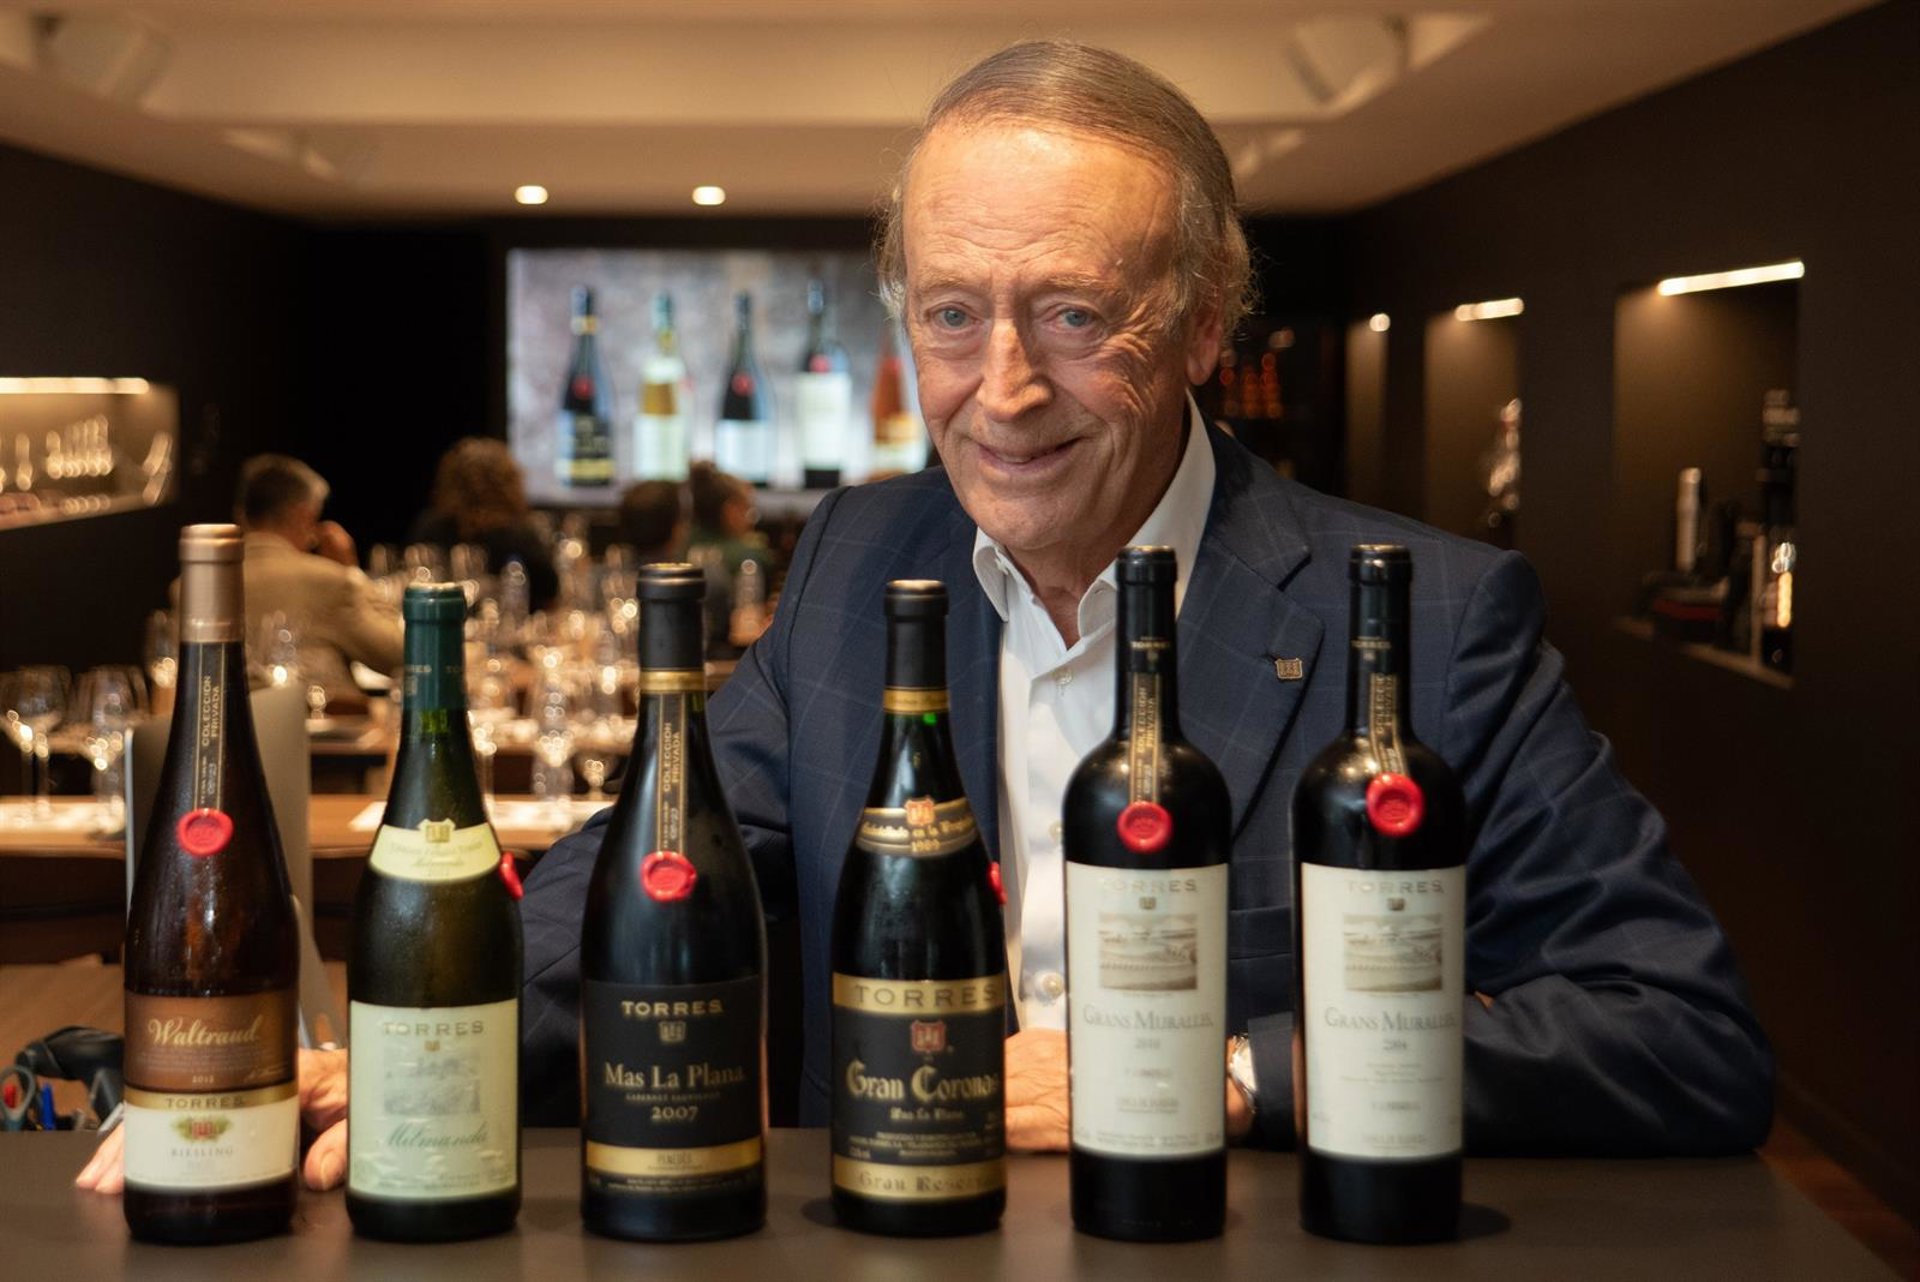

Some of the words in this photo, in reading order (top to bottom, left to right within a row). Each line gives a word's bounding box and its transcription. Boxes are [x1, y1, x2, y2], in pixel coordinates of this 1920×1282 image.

[202, 675, 213, 748] COLECCION
[211, 686, 220, 739] PRIVADA
[663, 721, 673, 793] COLECCION
[672, 731, 681, 784] PRIVADA
[1347, 880, 1445, 894] TORRES
[622, 999, 724, 1017] TORRES
[855, 984, 998, 1008] TORRES
[148, 1014, 261, 1047] Waltraud
[383, 1020, 485, 1037] TORRES
[604, 1062, 645, 1087] Mas
[652, 1065, 680, 1088] La
[688, 1062, 745, 1088] Plana
[846, 1059, 905, 1101] Gran
[166, 1096, 245, 1109] TORRES
[651, 1105, 698, 1120] 2007
[171, 1147, 234, 1158] RIESLING
